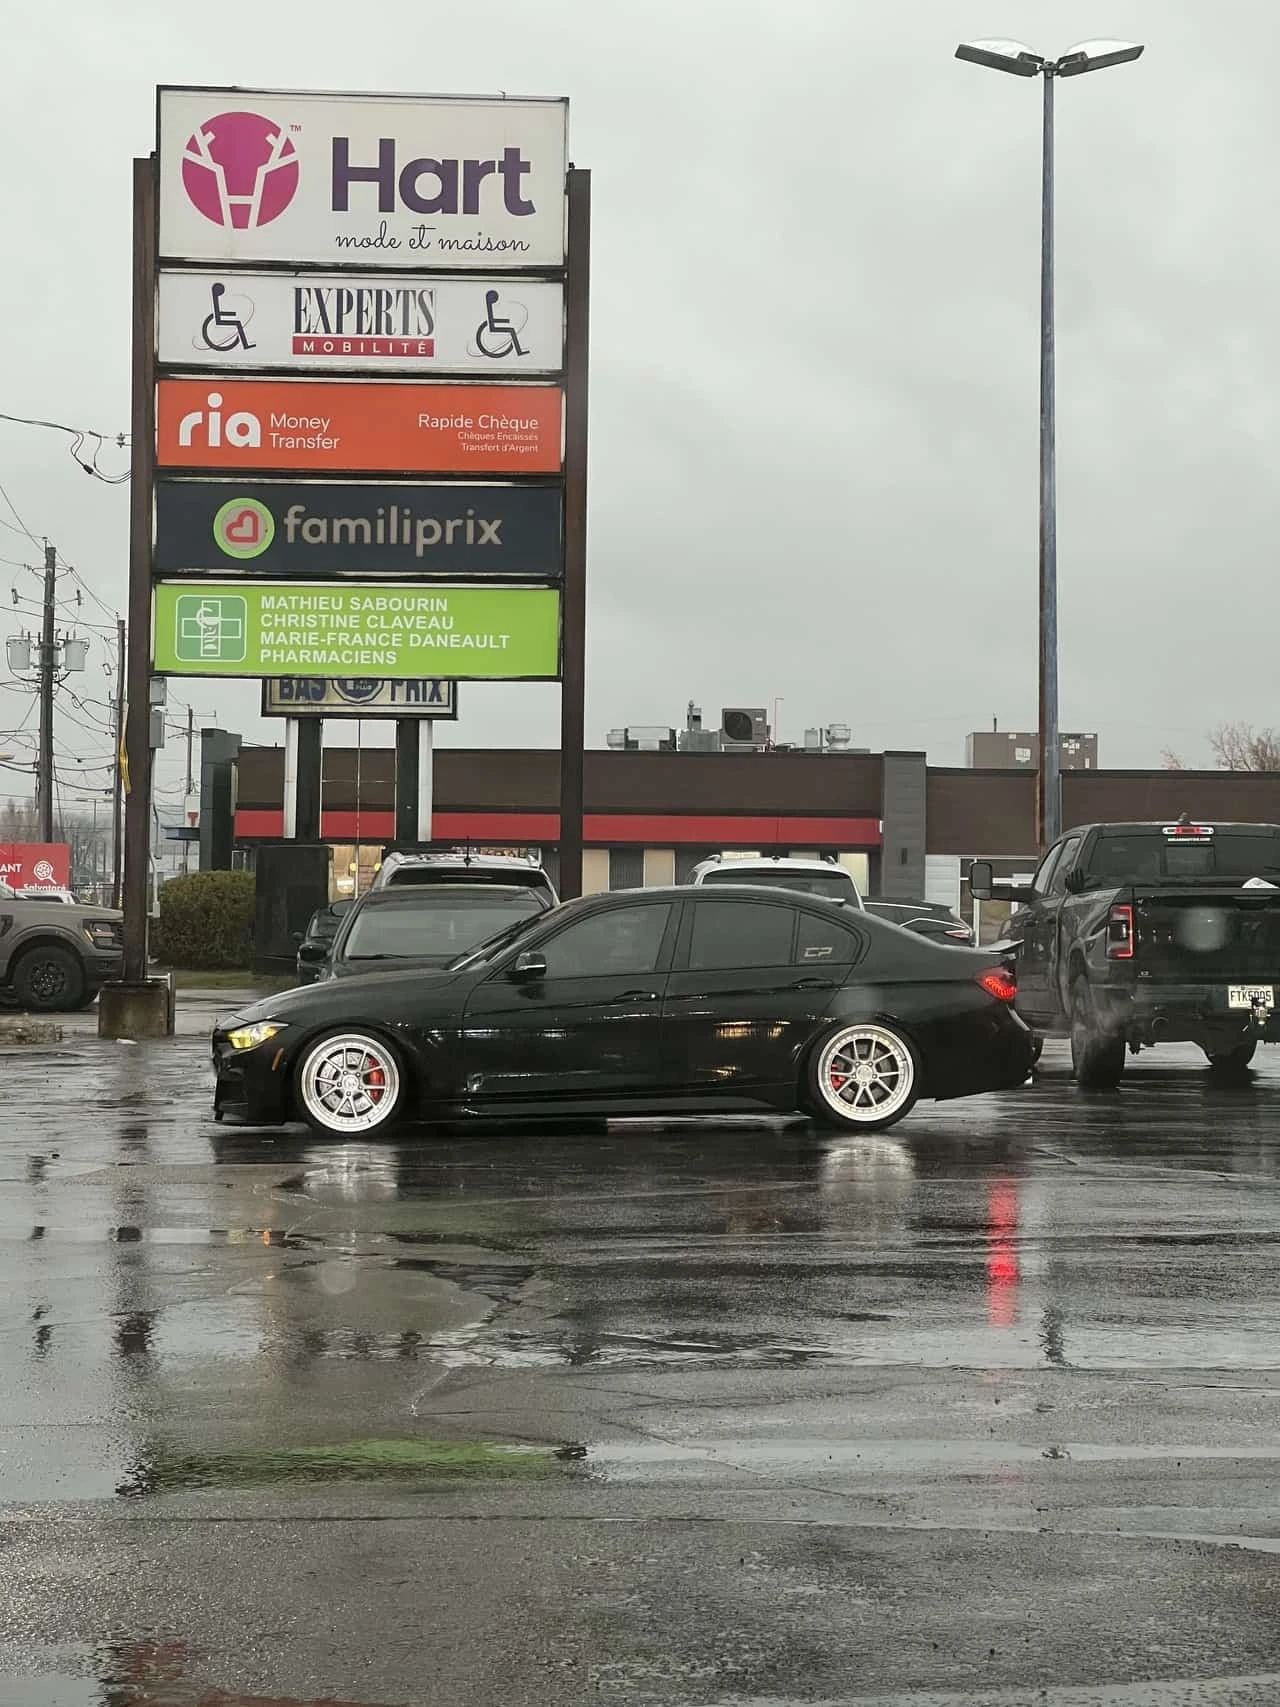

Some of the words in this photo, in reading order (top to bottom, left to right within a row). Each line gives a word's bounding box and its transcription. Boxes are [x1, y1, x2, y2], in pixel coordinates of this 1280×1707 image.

[331, 136, 537, 217] Hart
[335, 220, 402, 248] mode
[408, 224, 437, 249] et
[438, 231, 530, 251] maison
[294, 287, 435, 337] EXPERTS
[303, 341, 426, 354] MOBILITÉ
[179, 392, 261, 448] ria
[270, 413, 331, 432] Money
[418, 413, 473, 430] Rapide
[478, 414, 539, 432] Chèque
[269, 432, 341, 449] Transfer
[457, 431, 495, 442] Chèques
[462, 442, 499, 453] Transfert
[501, 443, 538, 454] d'Argent
[283, 505, 503, 557] familiprix
[260, 595, 343, 610] MATHIEU
[350, 597, 448, 612] SABOURIN
[260, 613, 360, 629] CHRISTINE
[366, 615, 454, 630] CLAVEAU
[260, 631, 402, 647] MARIE-FRANCE
[409, 633, 511, 649] DANEAULT
[260, 649, 397, 665] PHARMACIENS
[0, 863, 22, 873] ANT
